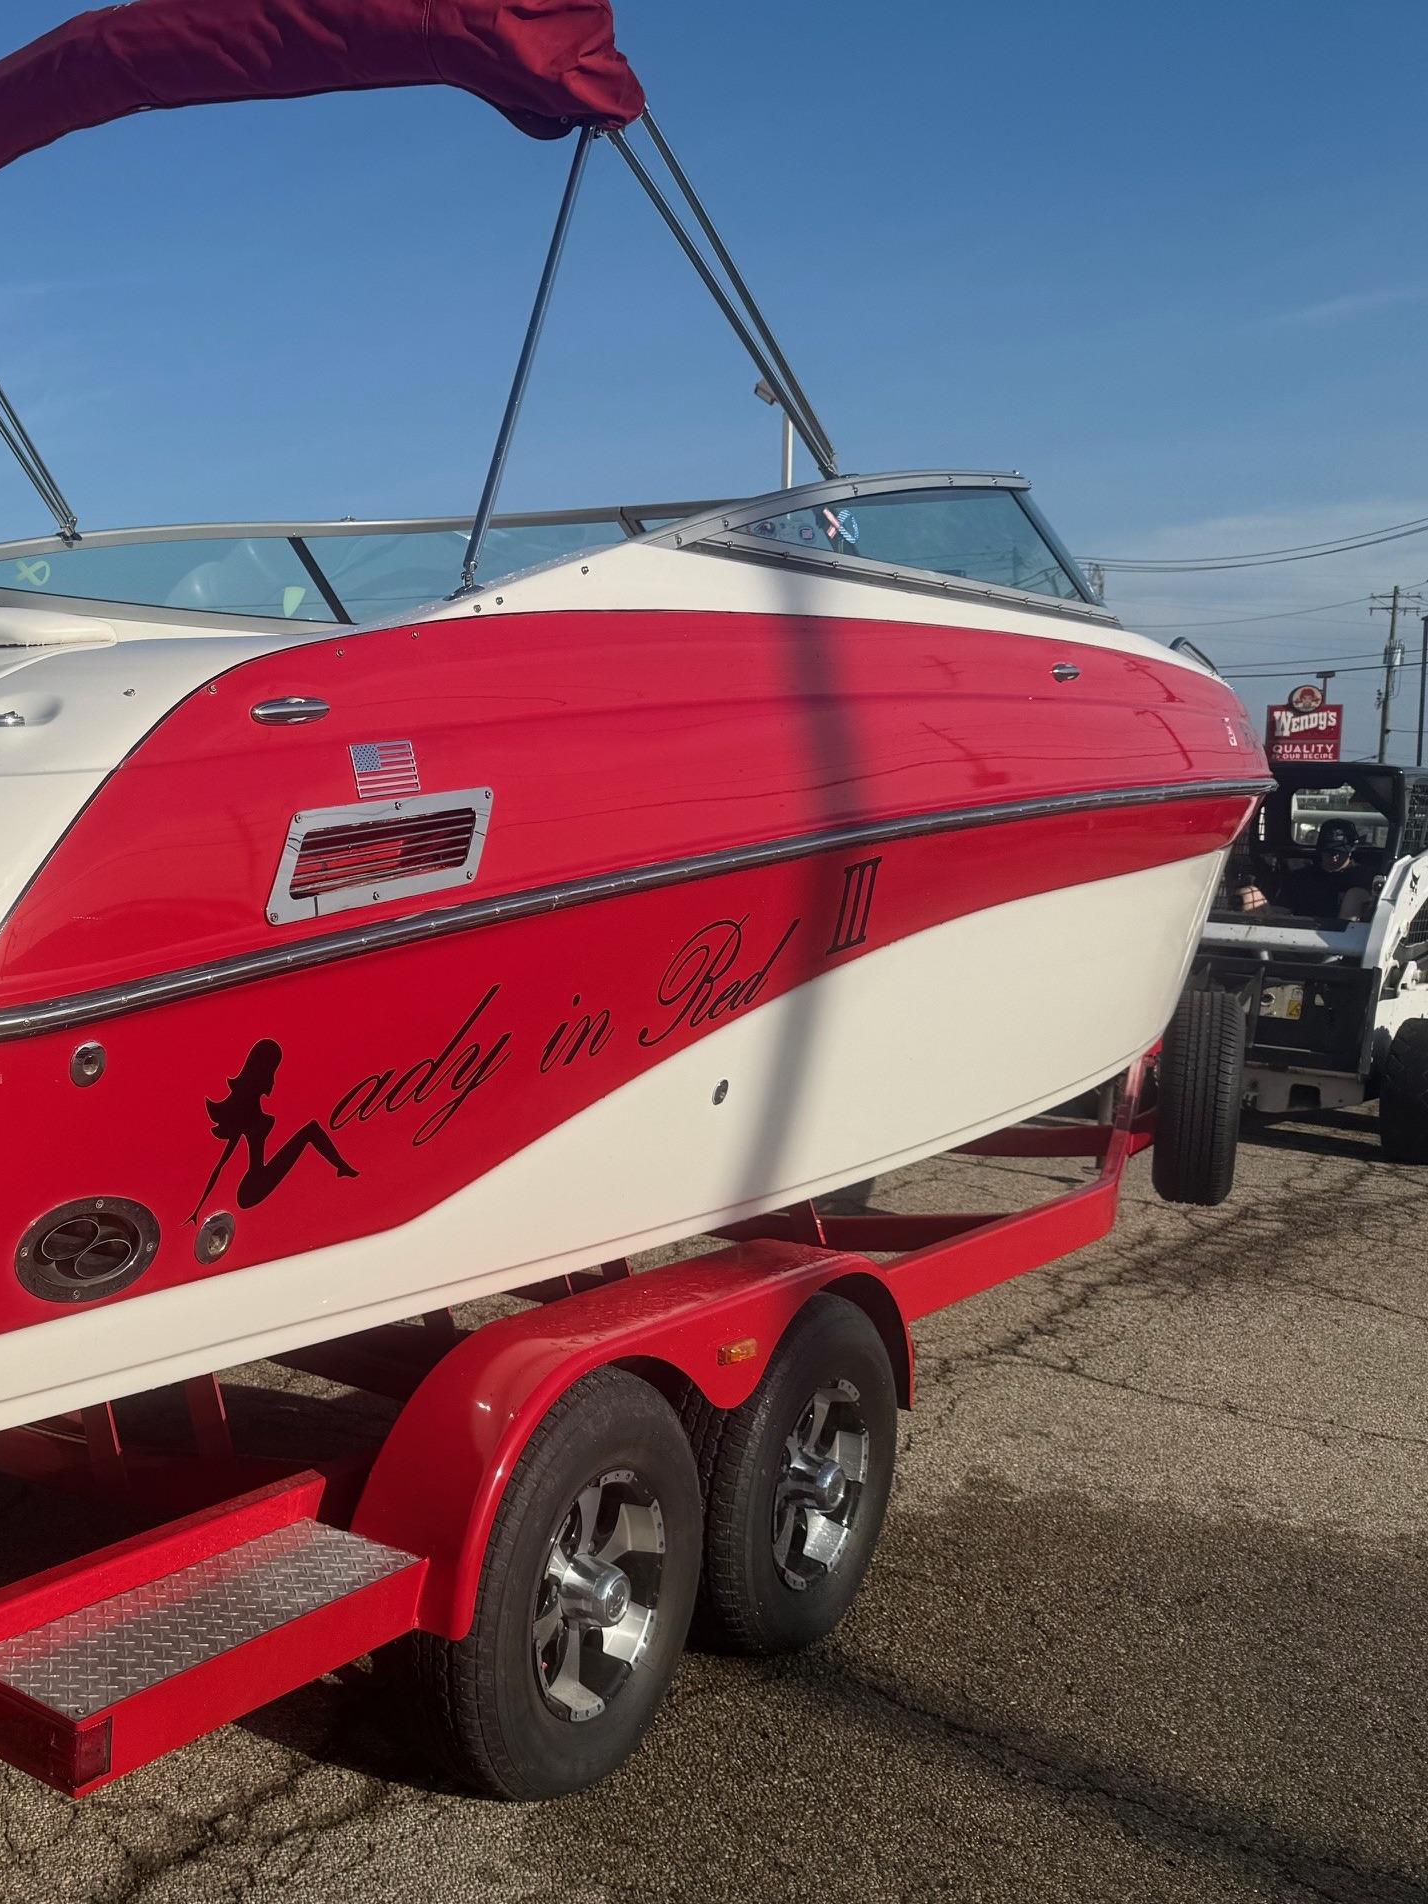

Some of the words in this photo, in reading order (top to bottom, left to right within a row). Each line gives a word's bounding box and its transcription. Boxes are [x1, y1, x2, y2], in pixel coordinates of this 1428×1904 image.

[1272, 743, 1334, 754] QUALITY
[538, 993, 615, 1074] in
[637, 912, 802, 1048] Red
[825, 855, 883, 957] III
